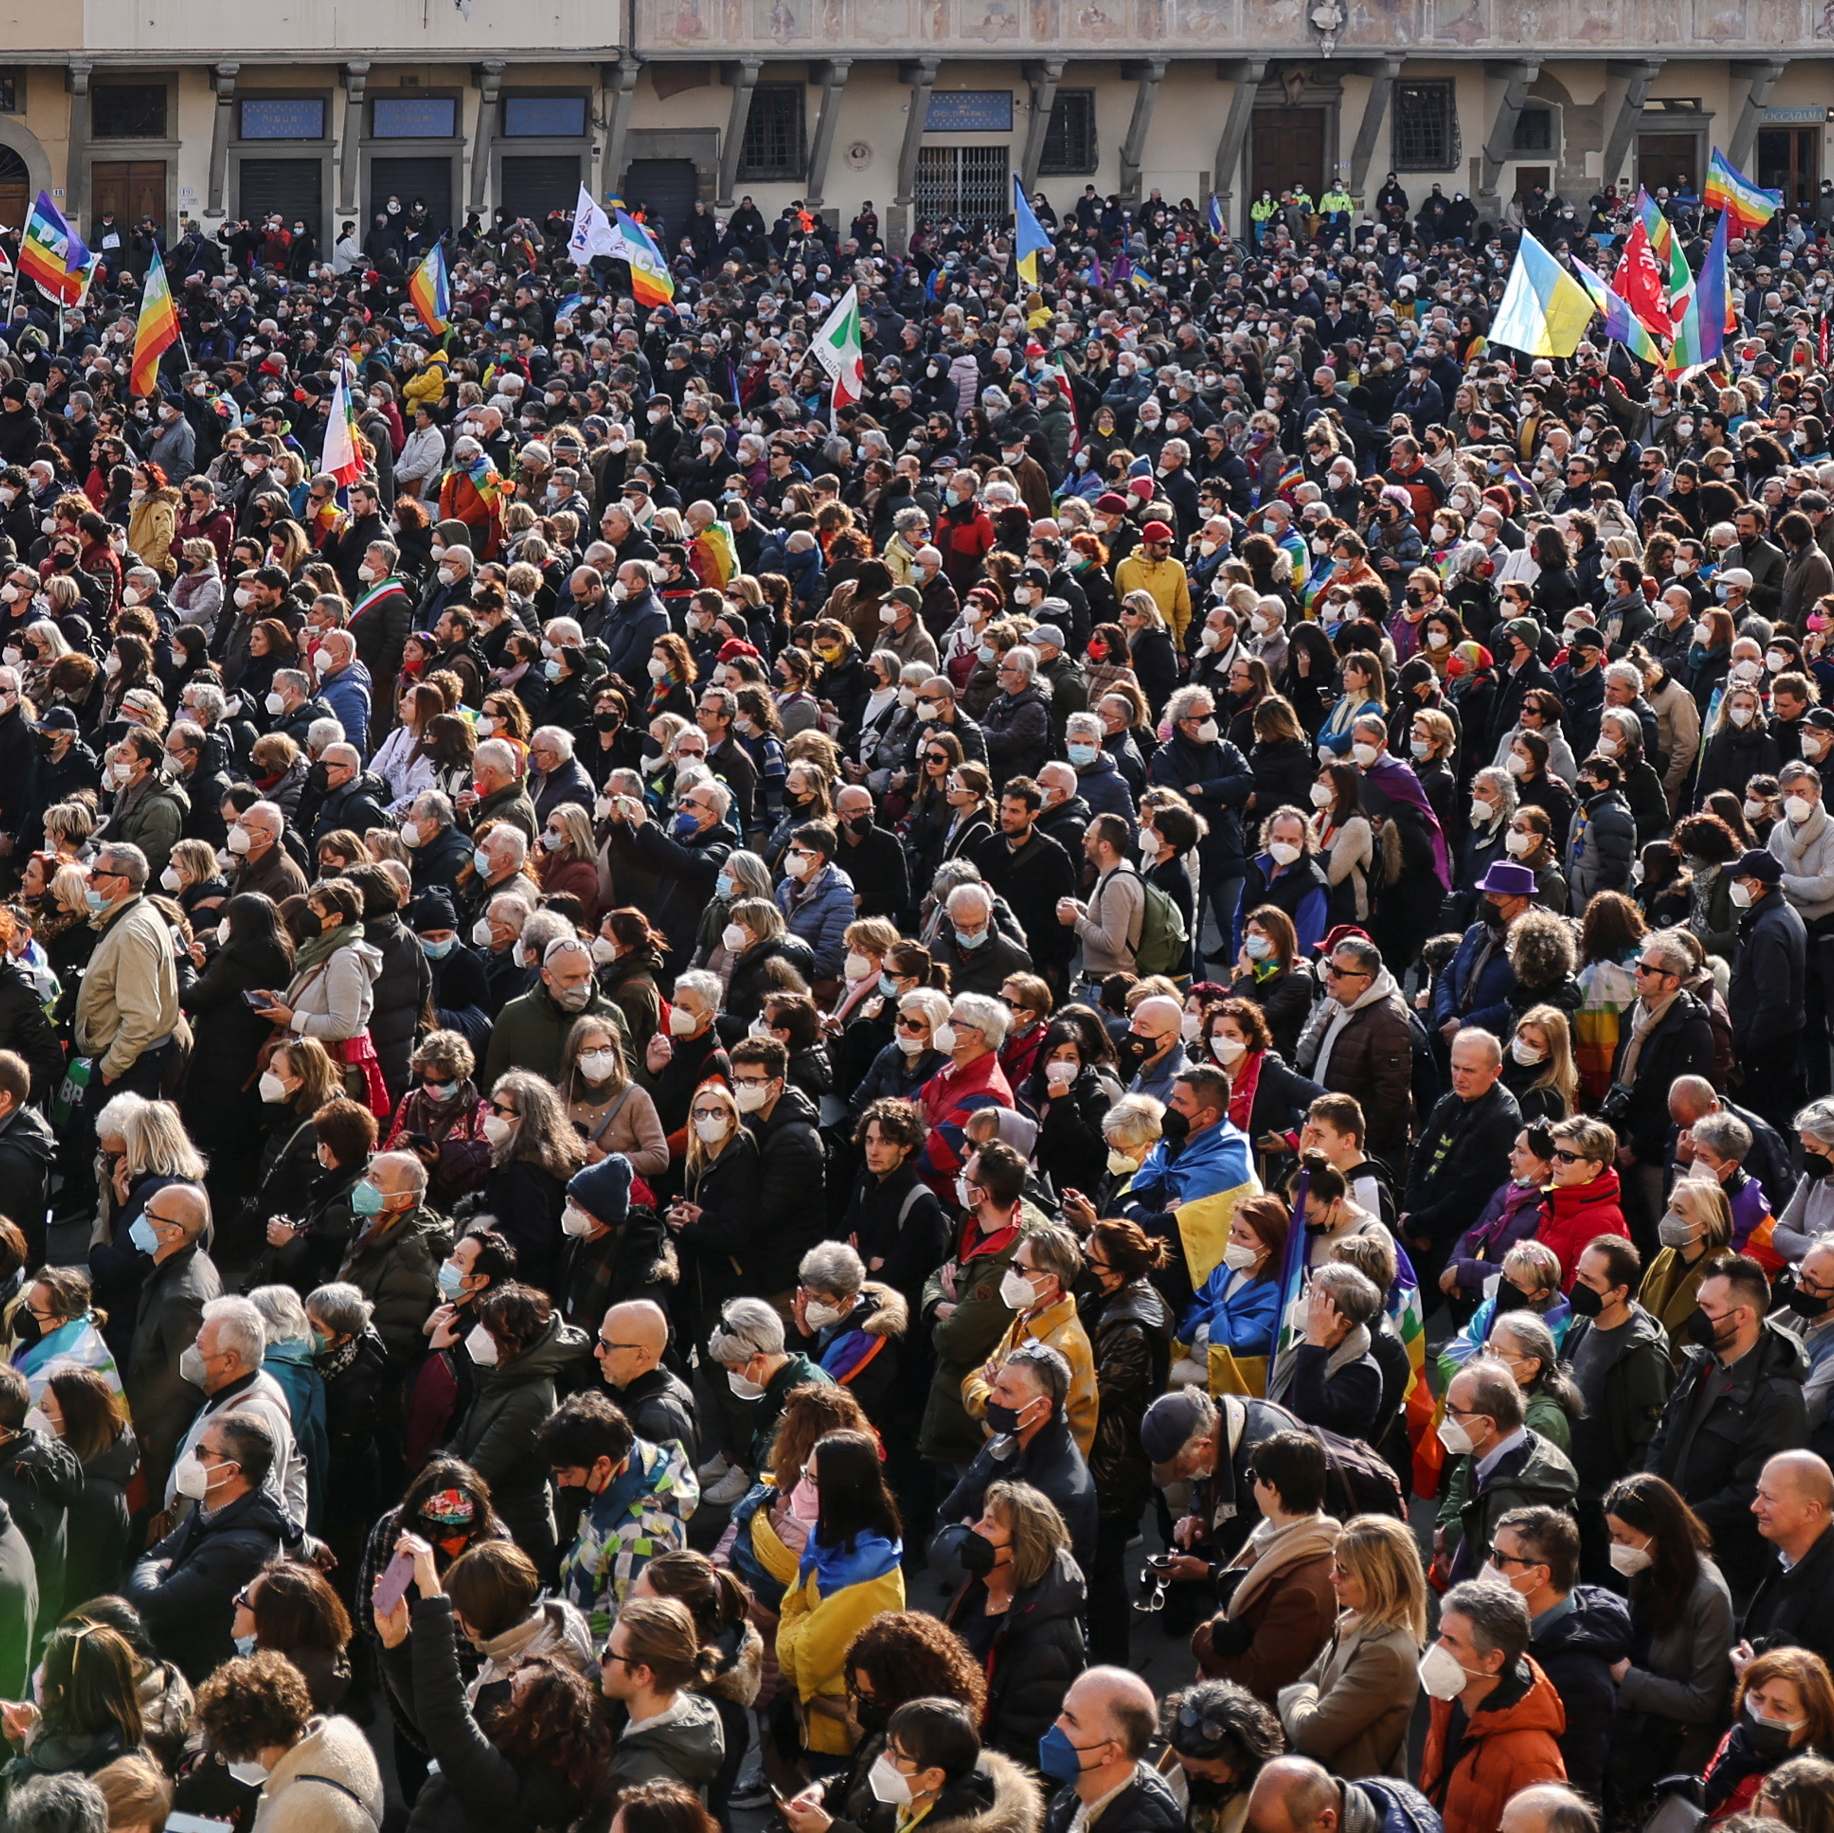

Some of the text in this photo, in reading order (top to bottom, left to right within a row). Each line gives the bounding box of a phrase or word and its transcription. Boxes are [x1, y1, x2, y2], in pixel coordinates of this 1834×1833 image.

[1765, 111, 1824, 121] OCCADAMA
[35, 224, 68, 259] PA
[816, 346, 840, 377] Partito
